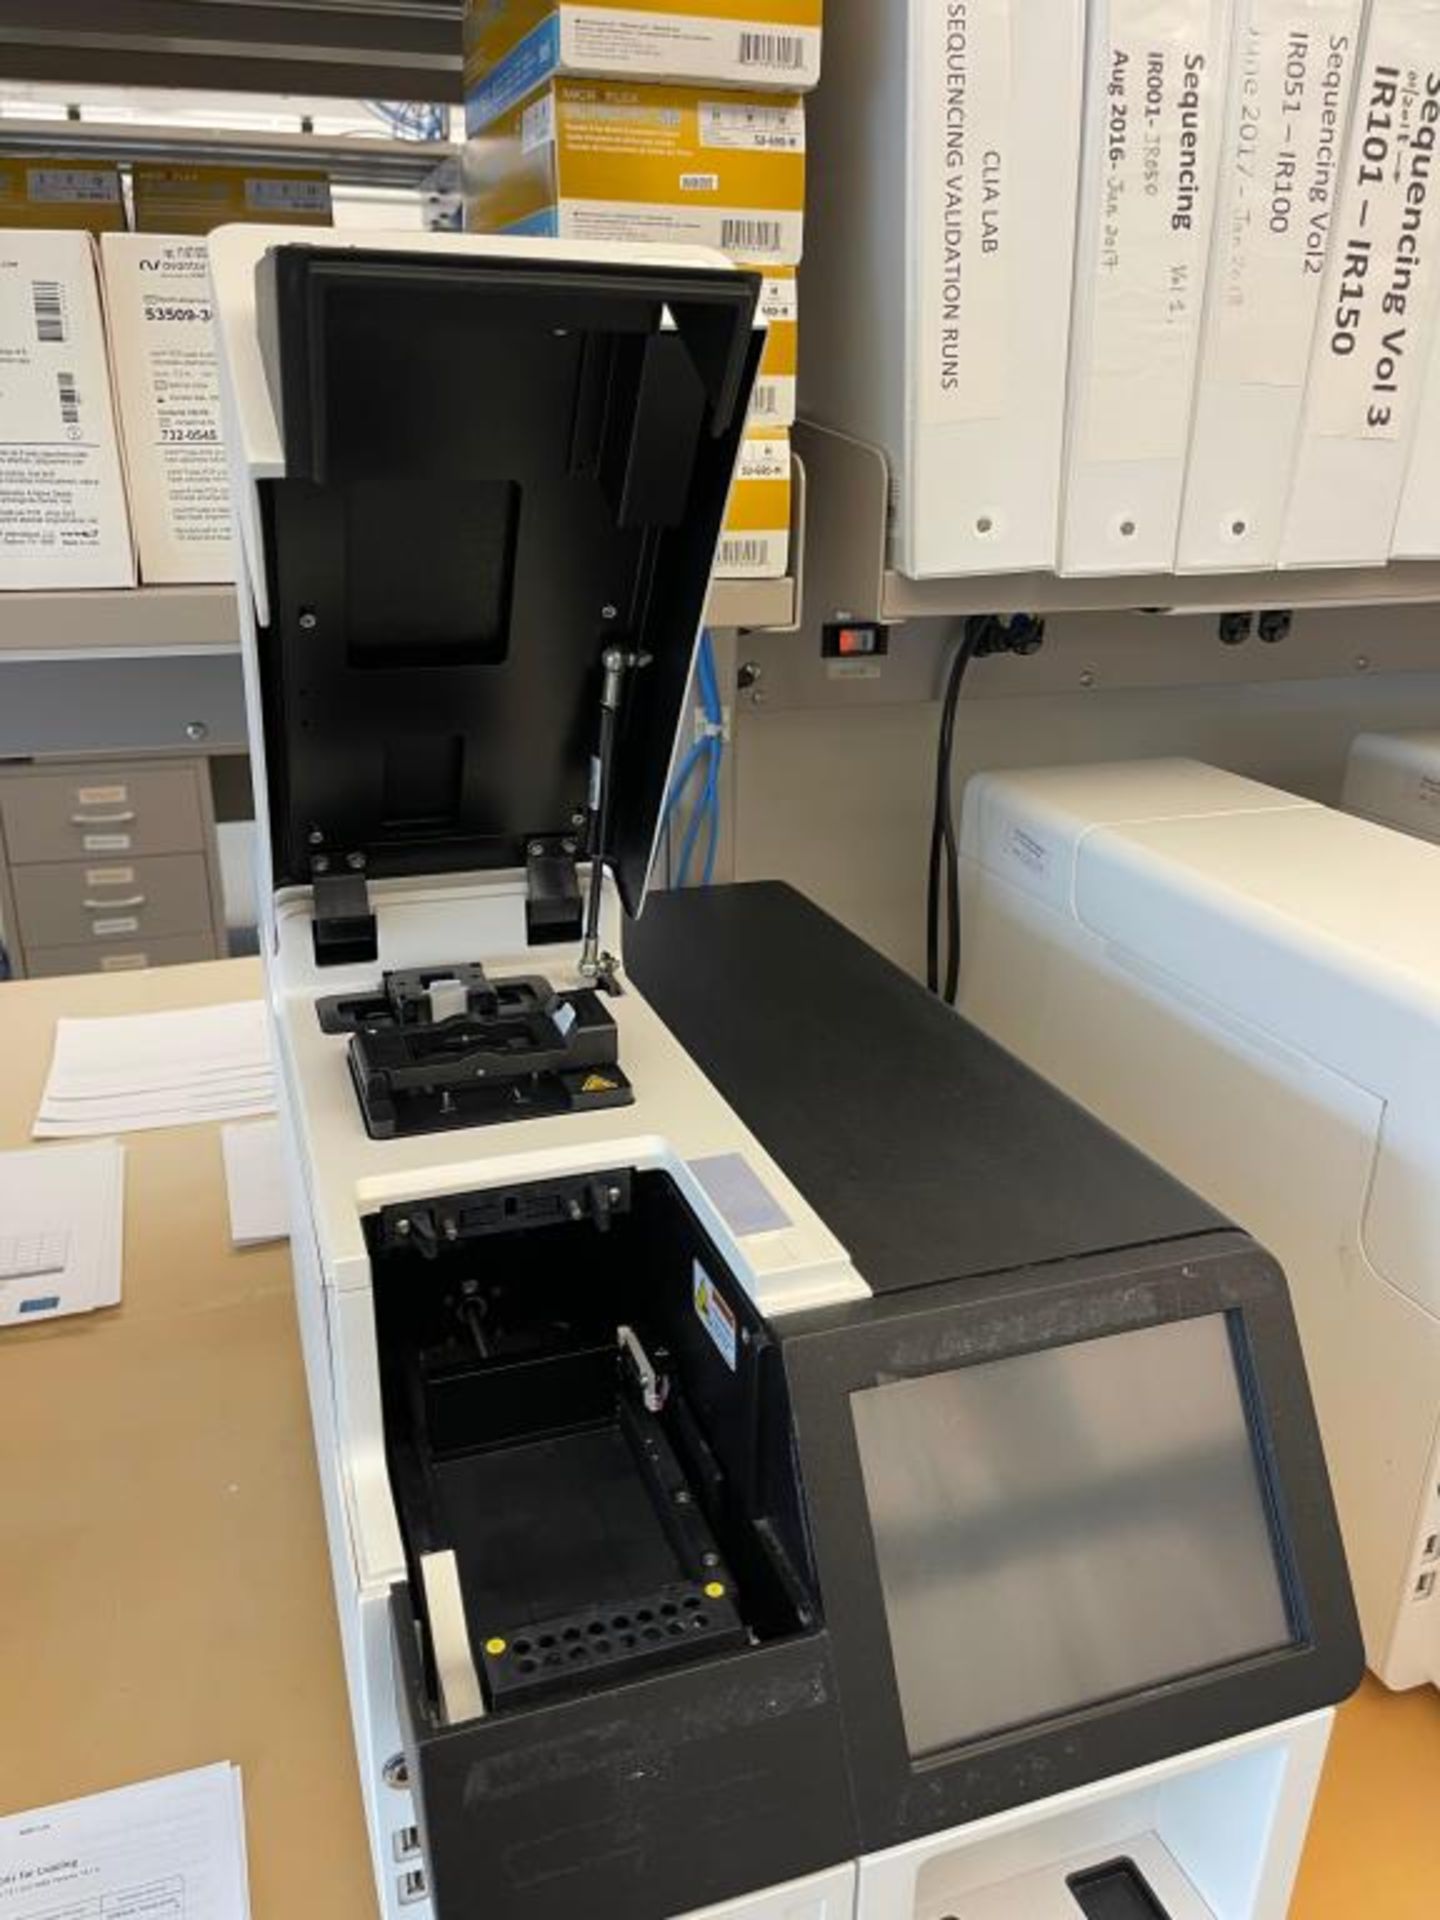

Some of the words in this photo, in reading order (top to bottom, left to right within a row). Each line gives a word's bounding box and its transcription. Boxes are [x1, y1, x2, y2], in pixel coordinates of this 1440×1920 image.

[945, 3, 966, 168] SEQUENCING
[1107, 50, 1129, 96] Aug
[1282, 31, 1309, 116] IR051
[1172, 54, 1206, 230] Sequencing
[1308, 35, 1349, 202] Sequencing
[1357, 66, 1401, 186] IR101
[982, 151, 1001, 201] CLIA
[1269, 151, 1297, 233] IR100
[1381, 72, 1440, 316] Sequencing
[942, 174, 963, 320] VALIDATION
[981, 211, 999, 253] LAB
[1303, 211, 1329, 274] Vol2
[1331, 239, 1372, 355] IR150
[941, 328, 959, 390] RUNS
[1372, 329, 1406, 392] Vol
[1366, 404, 1391, 427] 3
